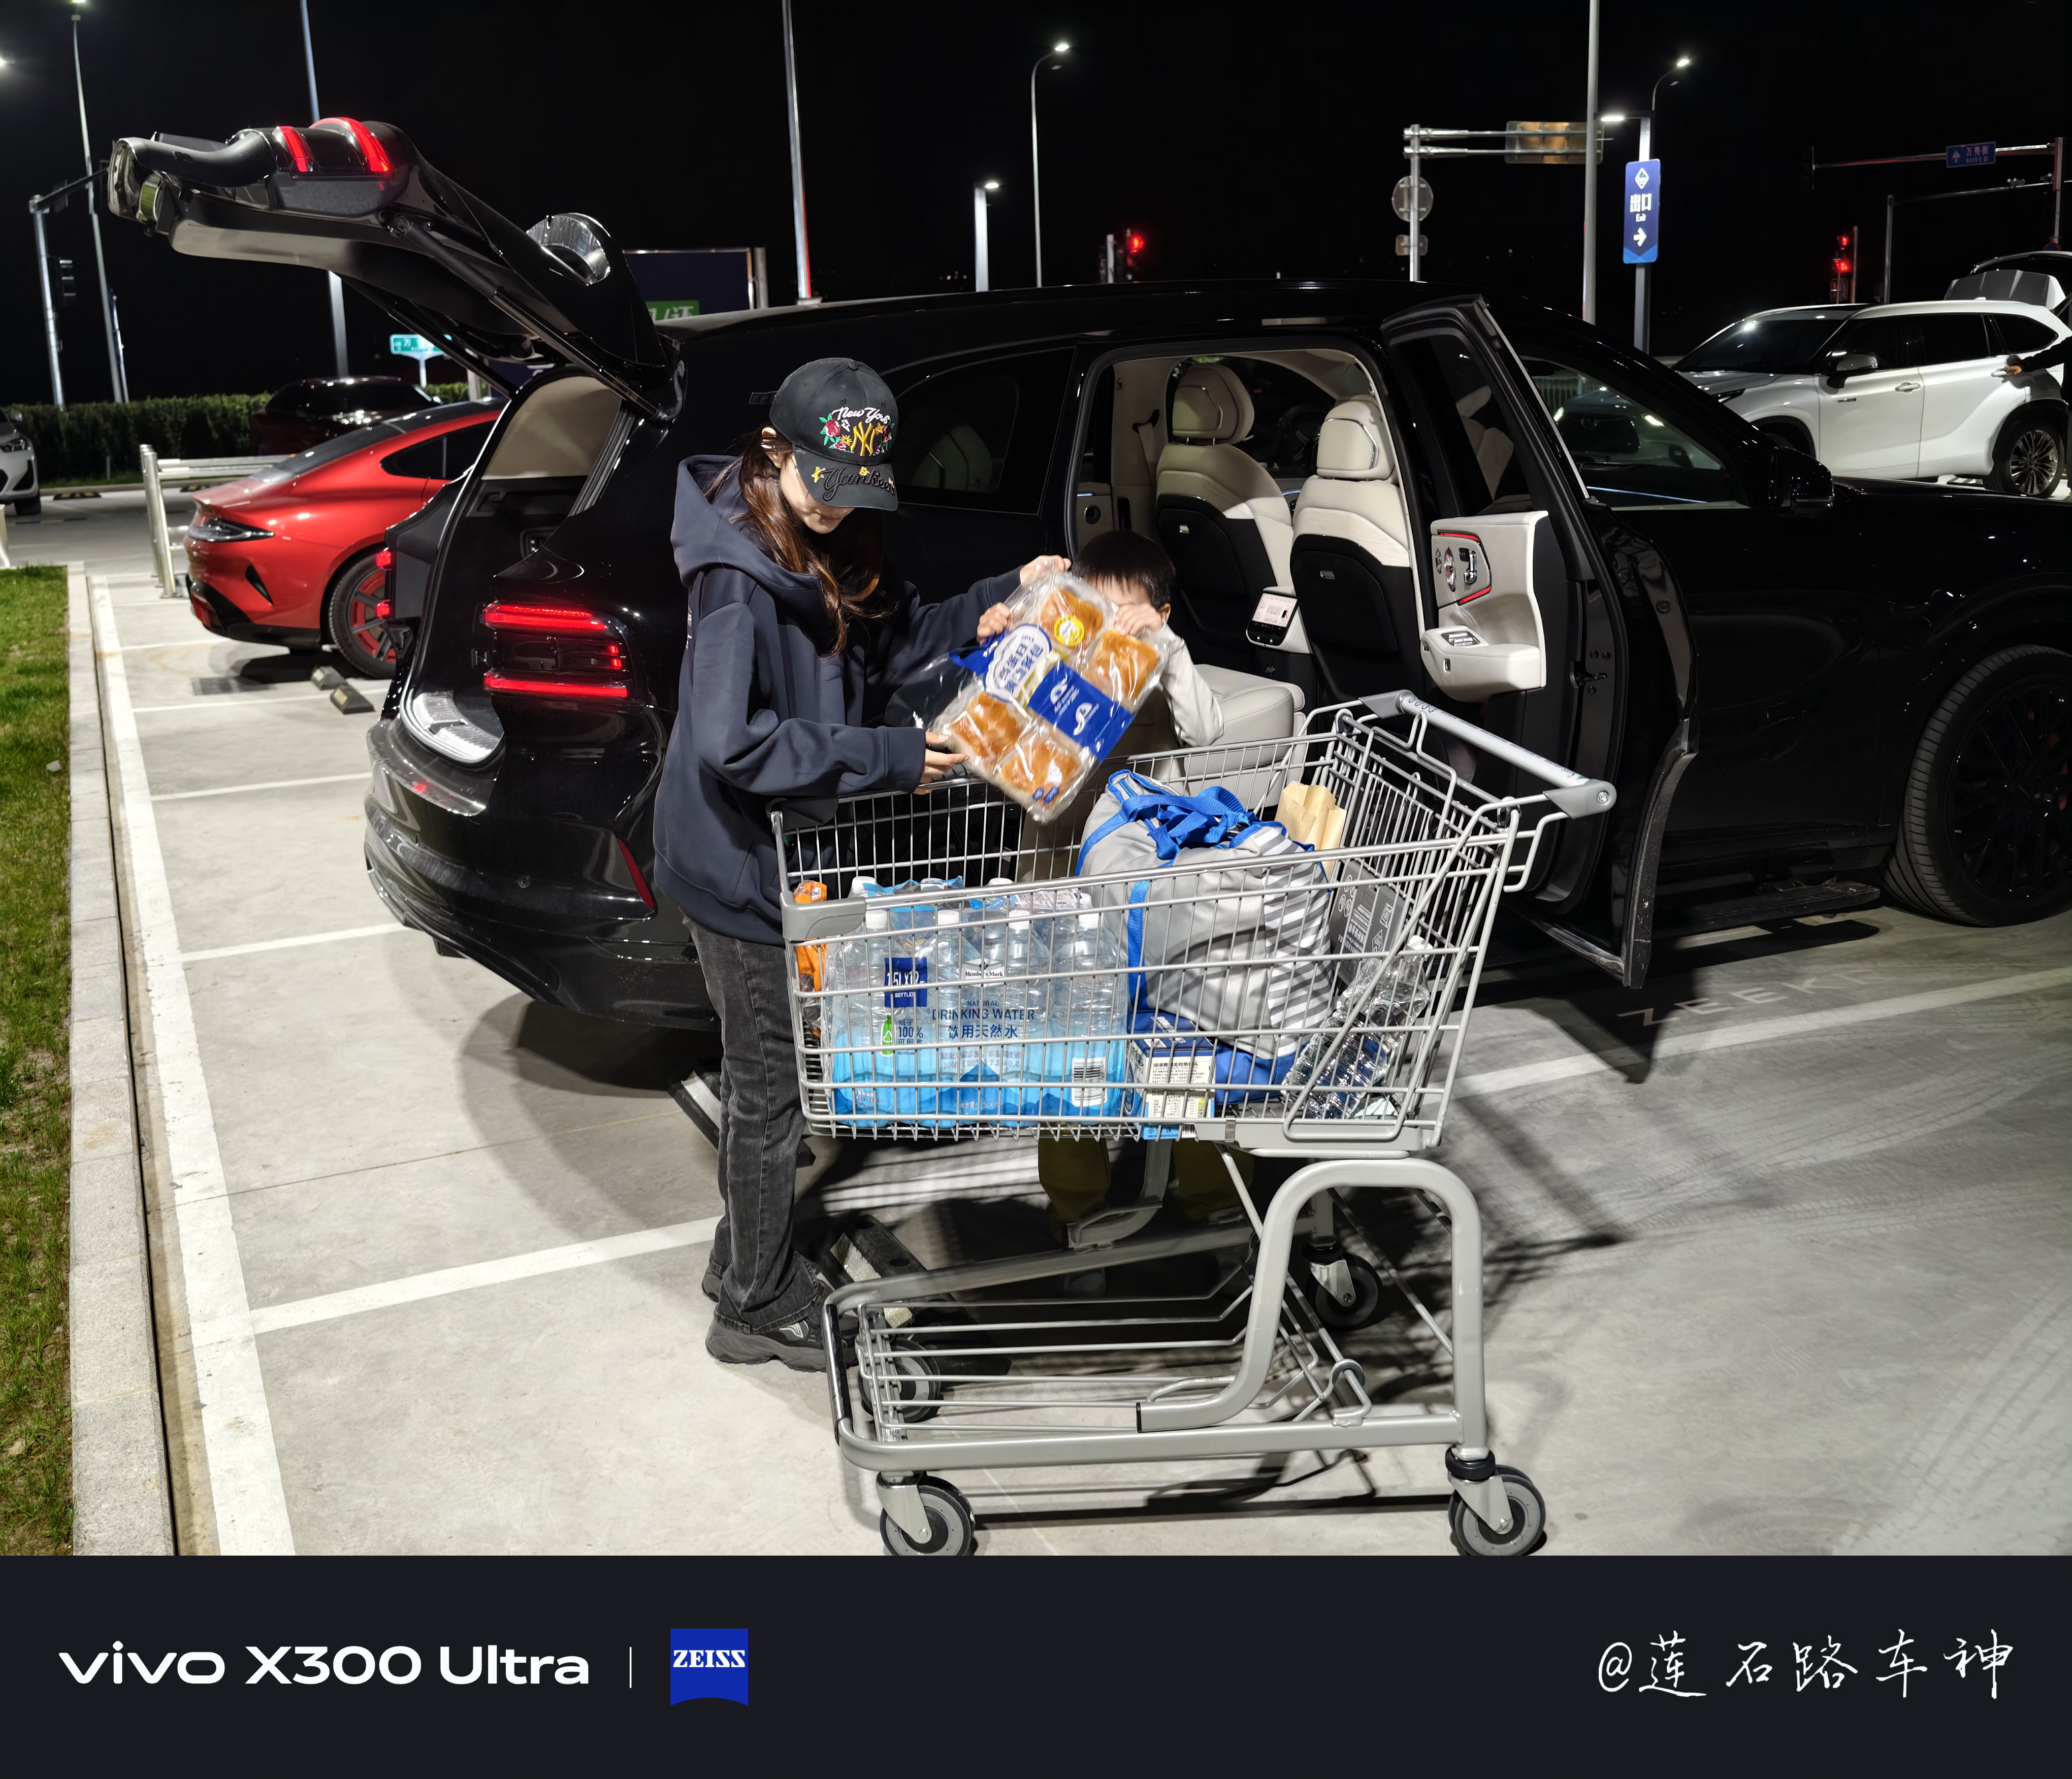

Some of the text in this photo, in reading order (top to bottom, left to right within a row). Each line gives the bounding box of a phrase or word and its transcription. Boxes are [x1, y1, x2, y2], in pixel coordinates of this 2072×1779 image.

[1630, 193, 1652, 212] 出口
[831, 407, 891, 424] New York
[819, 467, 895, 501] Yankees
[932, 1008, 1035, 1020] DRINKING WATER
[898, 1027, 923, 1038] 100%
[948, 1024, 1019, 1039] 饮用天然水
